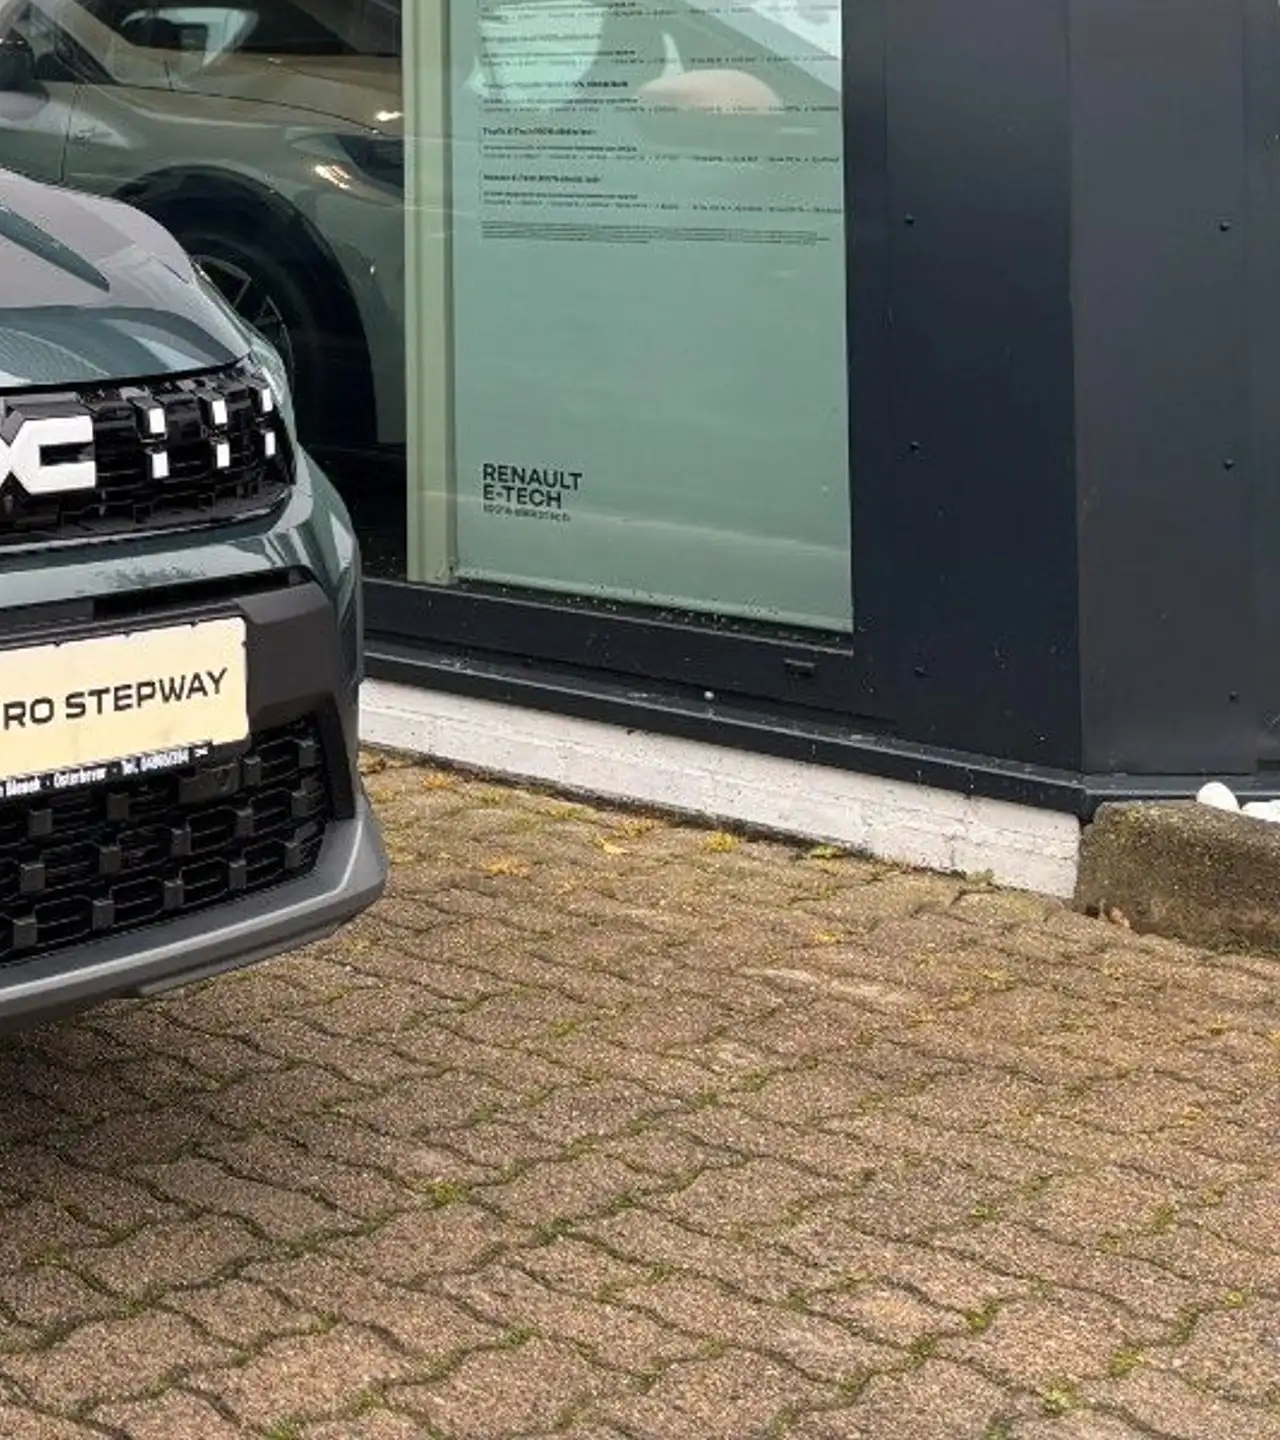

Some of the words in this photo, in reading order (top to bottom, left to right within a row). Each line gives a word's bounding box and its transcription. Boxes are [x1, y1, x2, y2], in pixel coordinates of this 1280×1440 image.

[482, 462, 583, 491] RENAULT
[482, 482, 562, 509] E-TECH
[64, 666, 229, 720] STEPWAY
